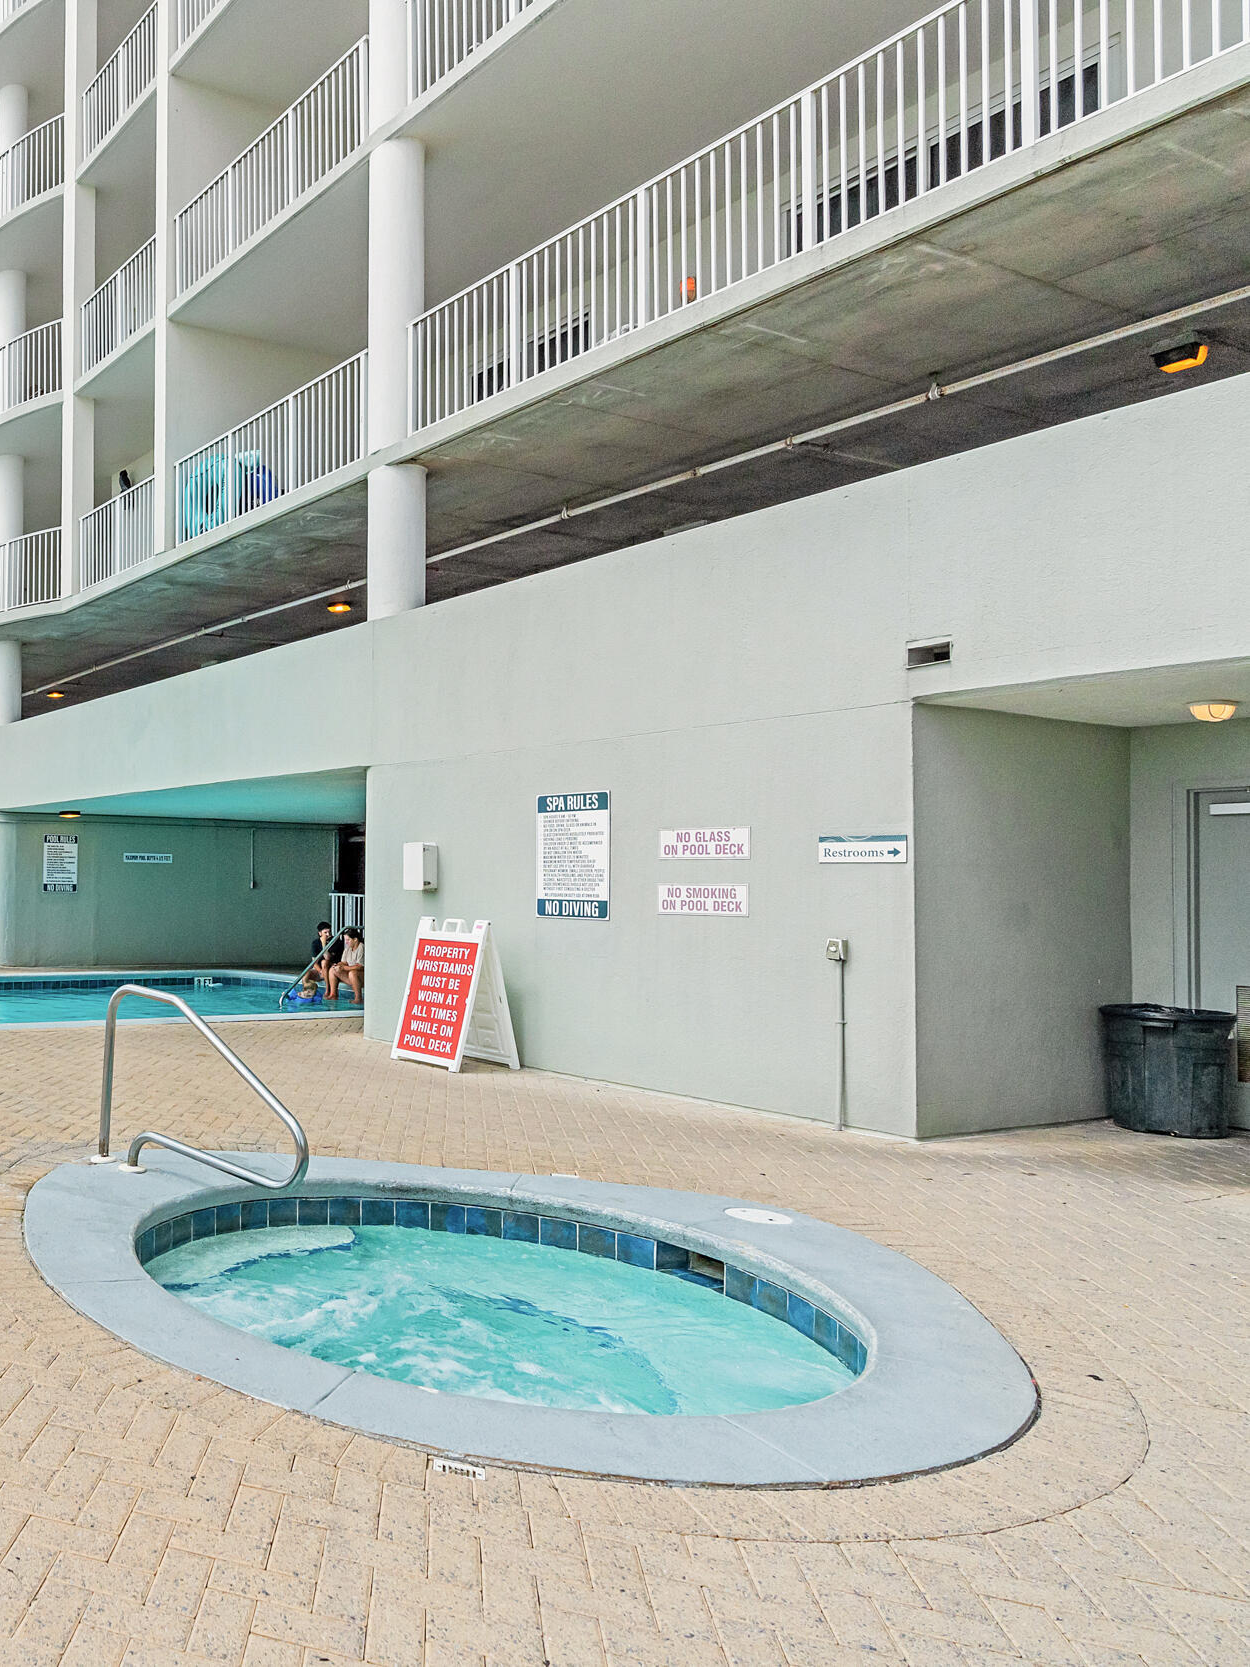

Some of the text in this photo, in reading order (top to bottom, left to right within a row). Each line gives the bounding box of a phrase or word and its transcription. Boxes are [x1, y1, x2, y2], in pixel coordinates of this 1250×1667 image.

[546, 794, 599, 811] SPA RULES
[46, 835, 76, 843] POOL RULES
[676, 831, 731, 843] NO GLASS
[664, 843, 744, 856] ON POOL DECK
[823, 848, 885, 858] Restrooms
[667, 887, 737, 899] NO SMOKING
[545, 901, 599, 917] NO DIVING
[662, 900, 742, 912] ON POOL DECK
[423, 945, 470, 960] PROPERTY
[416, 959, 473, 976] WRISTBANDS
[421, 975, 461, 990] MUST BE
[418, 990, 459, 1006] WORN AT
[411, 1004, 458, 1022] ALL TIMES
[410, 1020, 453, 1038] WHILE ON
[403, 1034, 452, 1054] POOL DECK
